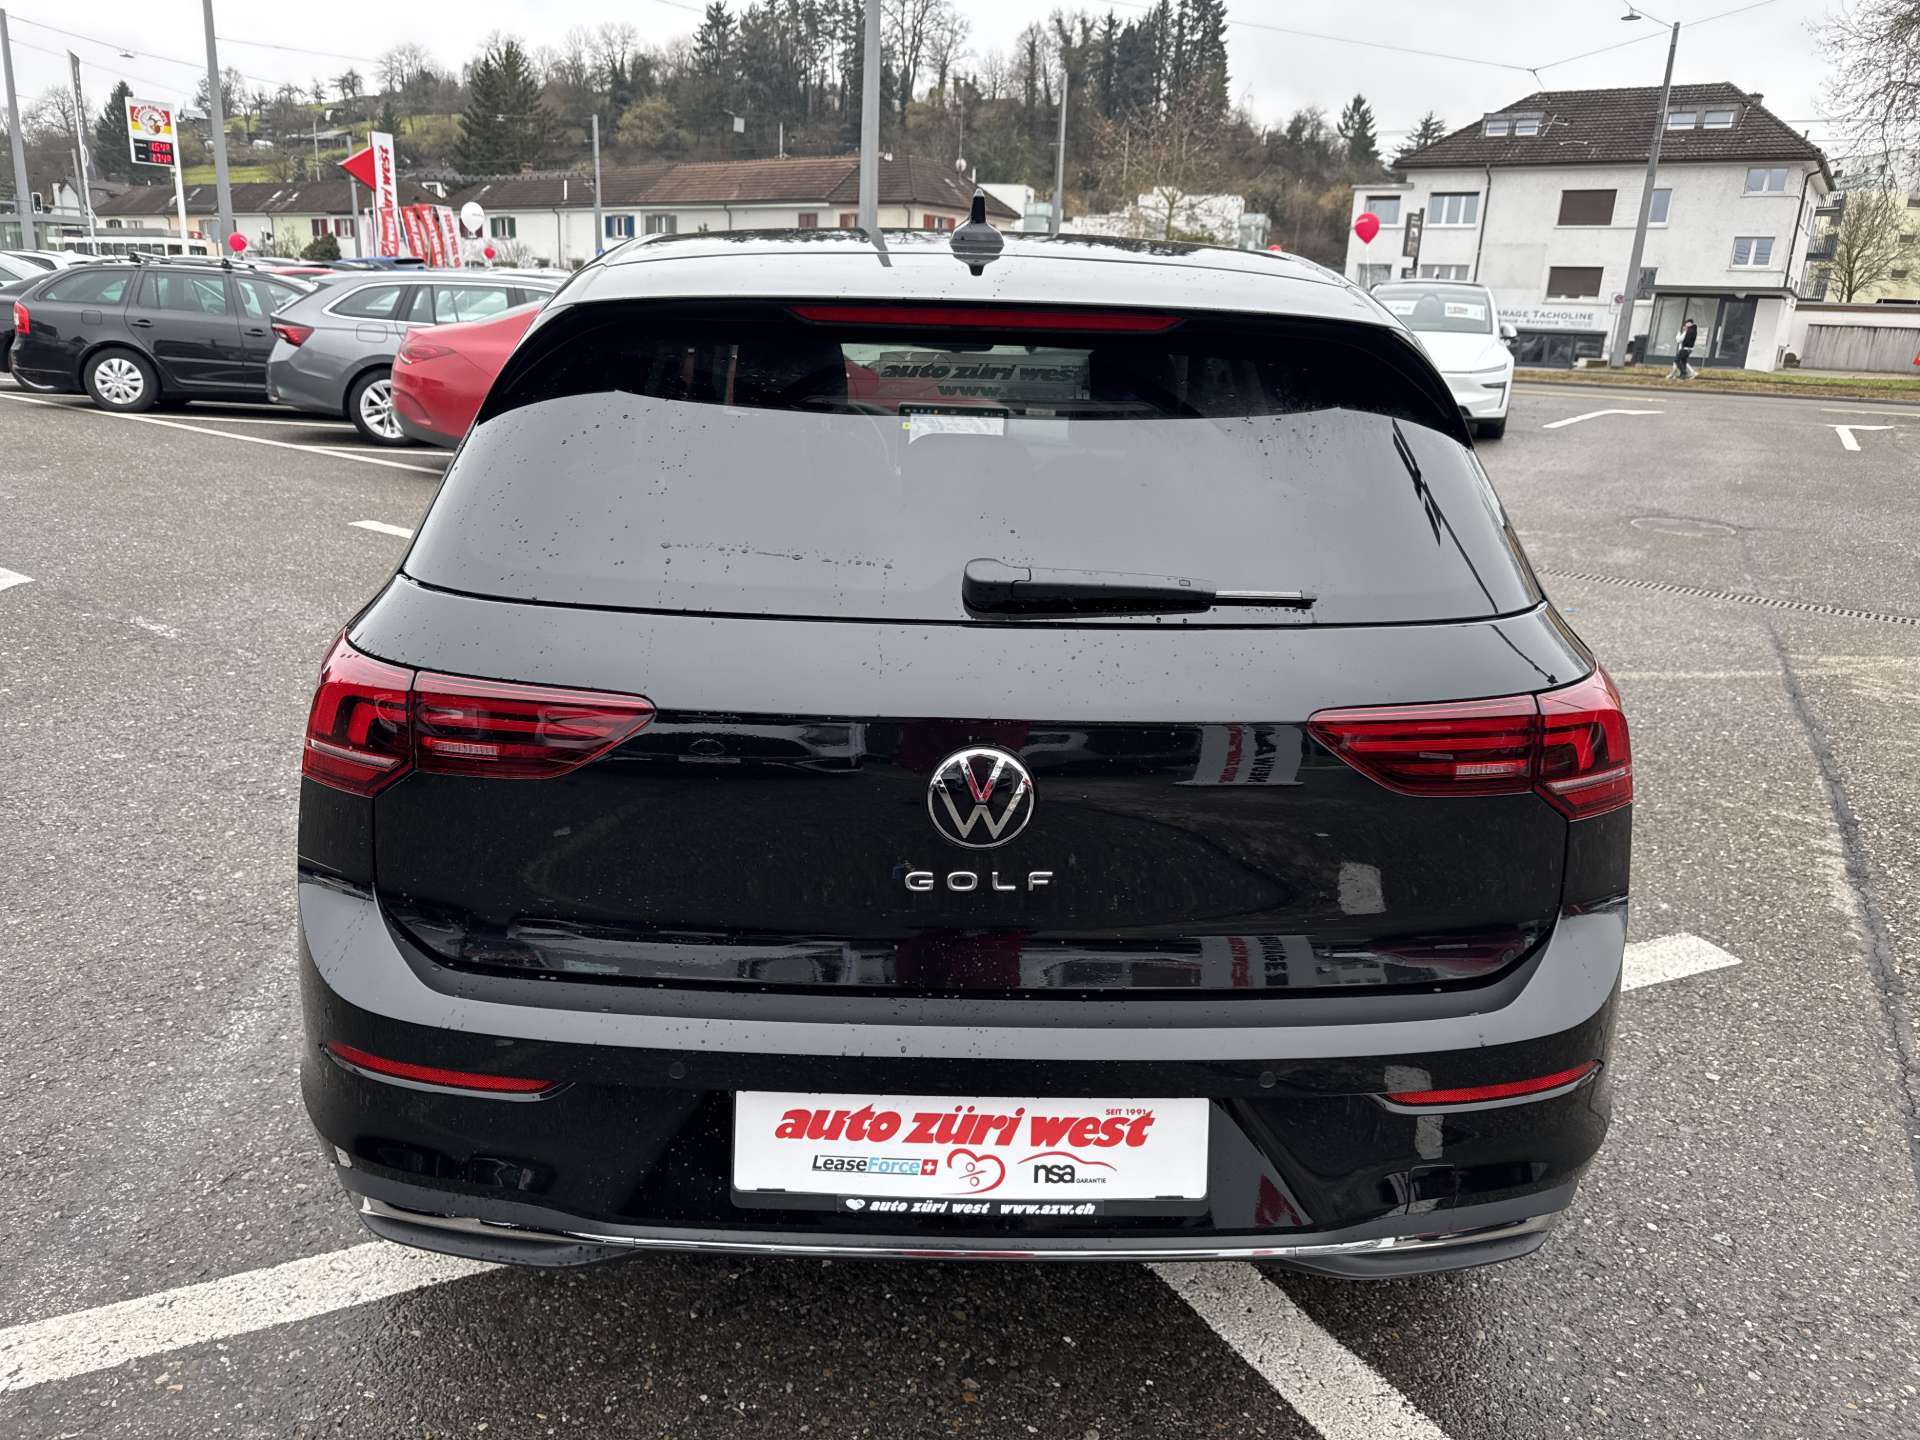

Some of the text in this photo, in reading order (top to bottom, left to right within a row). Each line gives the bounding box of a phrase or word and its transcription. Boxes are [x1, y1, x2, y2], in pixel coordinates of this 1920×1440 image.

[379, 145, 391, 186] west
[1497, 310, 1595, 321] ARAGE TACHOLINE
[904, 871, 1054, 892] GOLF
[1105, 1108, 1147, 1117] SEIT 1991
[774, 1103, 1156, 1148] auto züri west
[811, 1154, 921, 1175] LeaseForce
[1033, 1164, 1076, 1184] nsa
[869, 1200, 1097, 1216] auto züri west www.azw.ch
